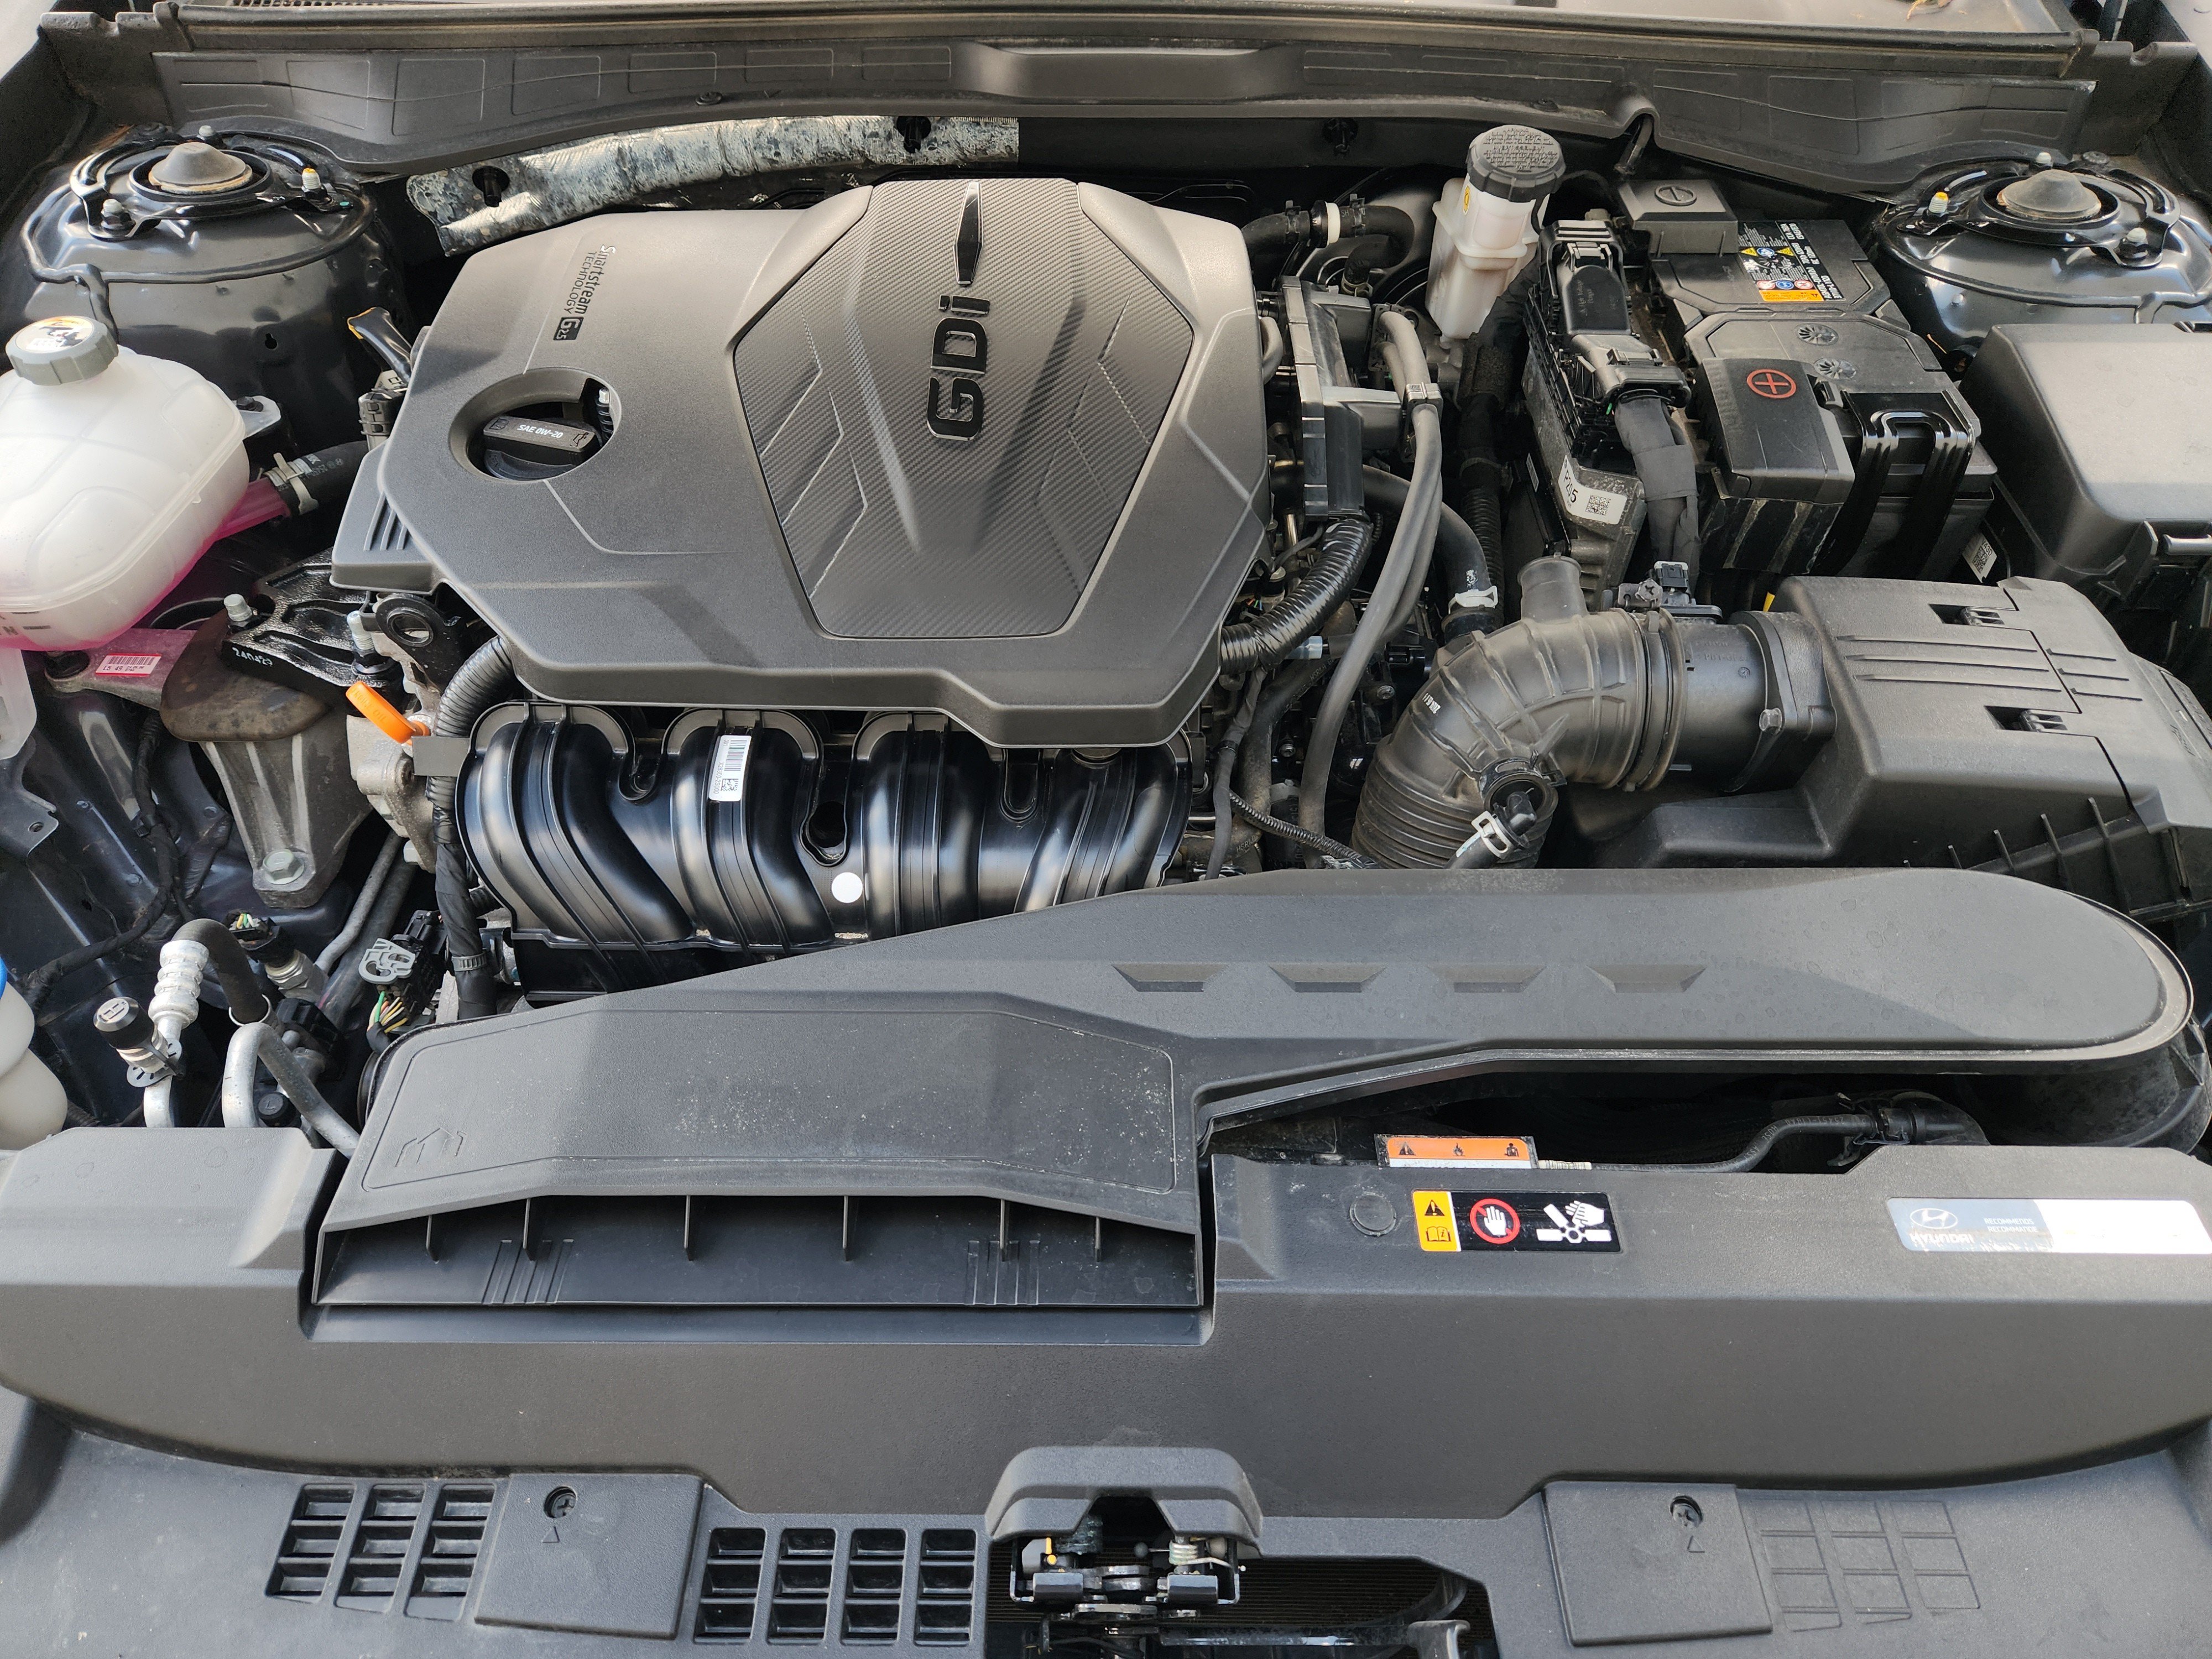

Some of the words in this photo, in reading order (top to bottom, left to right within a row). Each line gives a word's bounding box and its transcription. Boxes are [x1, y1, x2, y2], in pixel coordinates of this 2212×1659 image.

[564, 251, 597, 315] TECHNOLOGY
[574, 244, 616, 315] Smartstream
[927, 294, 990, 441] GDi
[517, 424, 536, 433] SAE
[535, 427, 564, 439] 0W-20
[1563, 469, 1578, 503] P205
[1909, 1232, 1975, 1244] HYUNDAI
